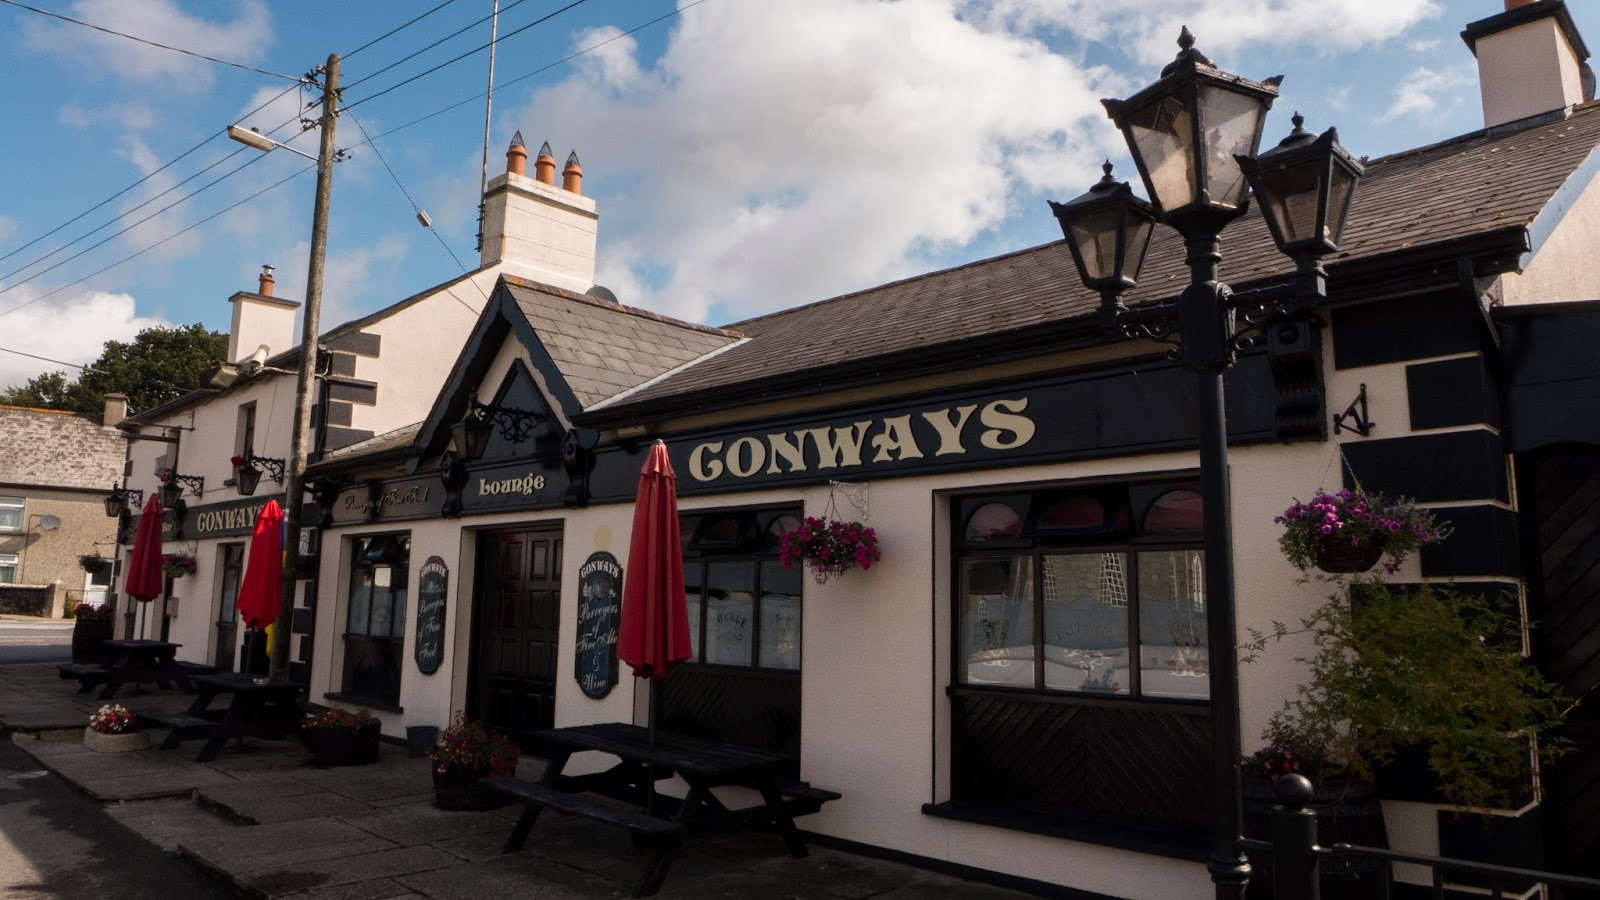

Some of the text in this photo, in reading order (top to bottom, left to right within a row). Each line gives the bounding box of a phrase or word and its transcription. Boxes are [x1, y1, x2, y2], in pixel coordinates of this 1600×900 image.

[689, 396, 1036, 482] CONWAYS
[479, 473, 545, 496] Lounge
[420, 563, 446, 577] CONWAYS
[581, 560, 619, 578] CONWAYS
[592, 616, 604, 638] of
[576, 627, 618, 653] Fine Ale
[583, 674, 607, 691] Wine
